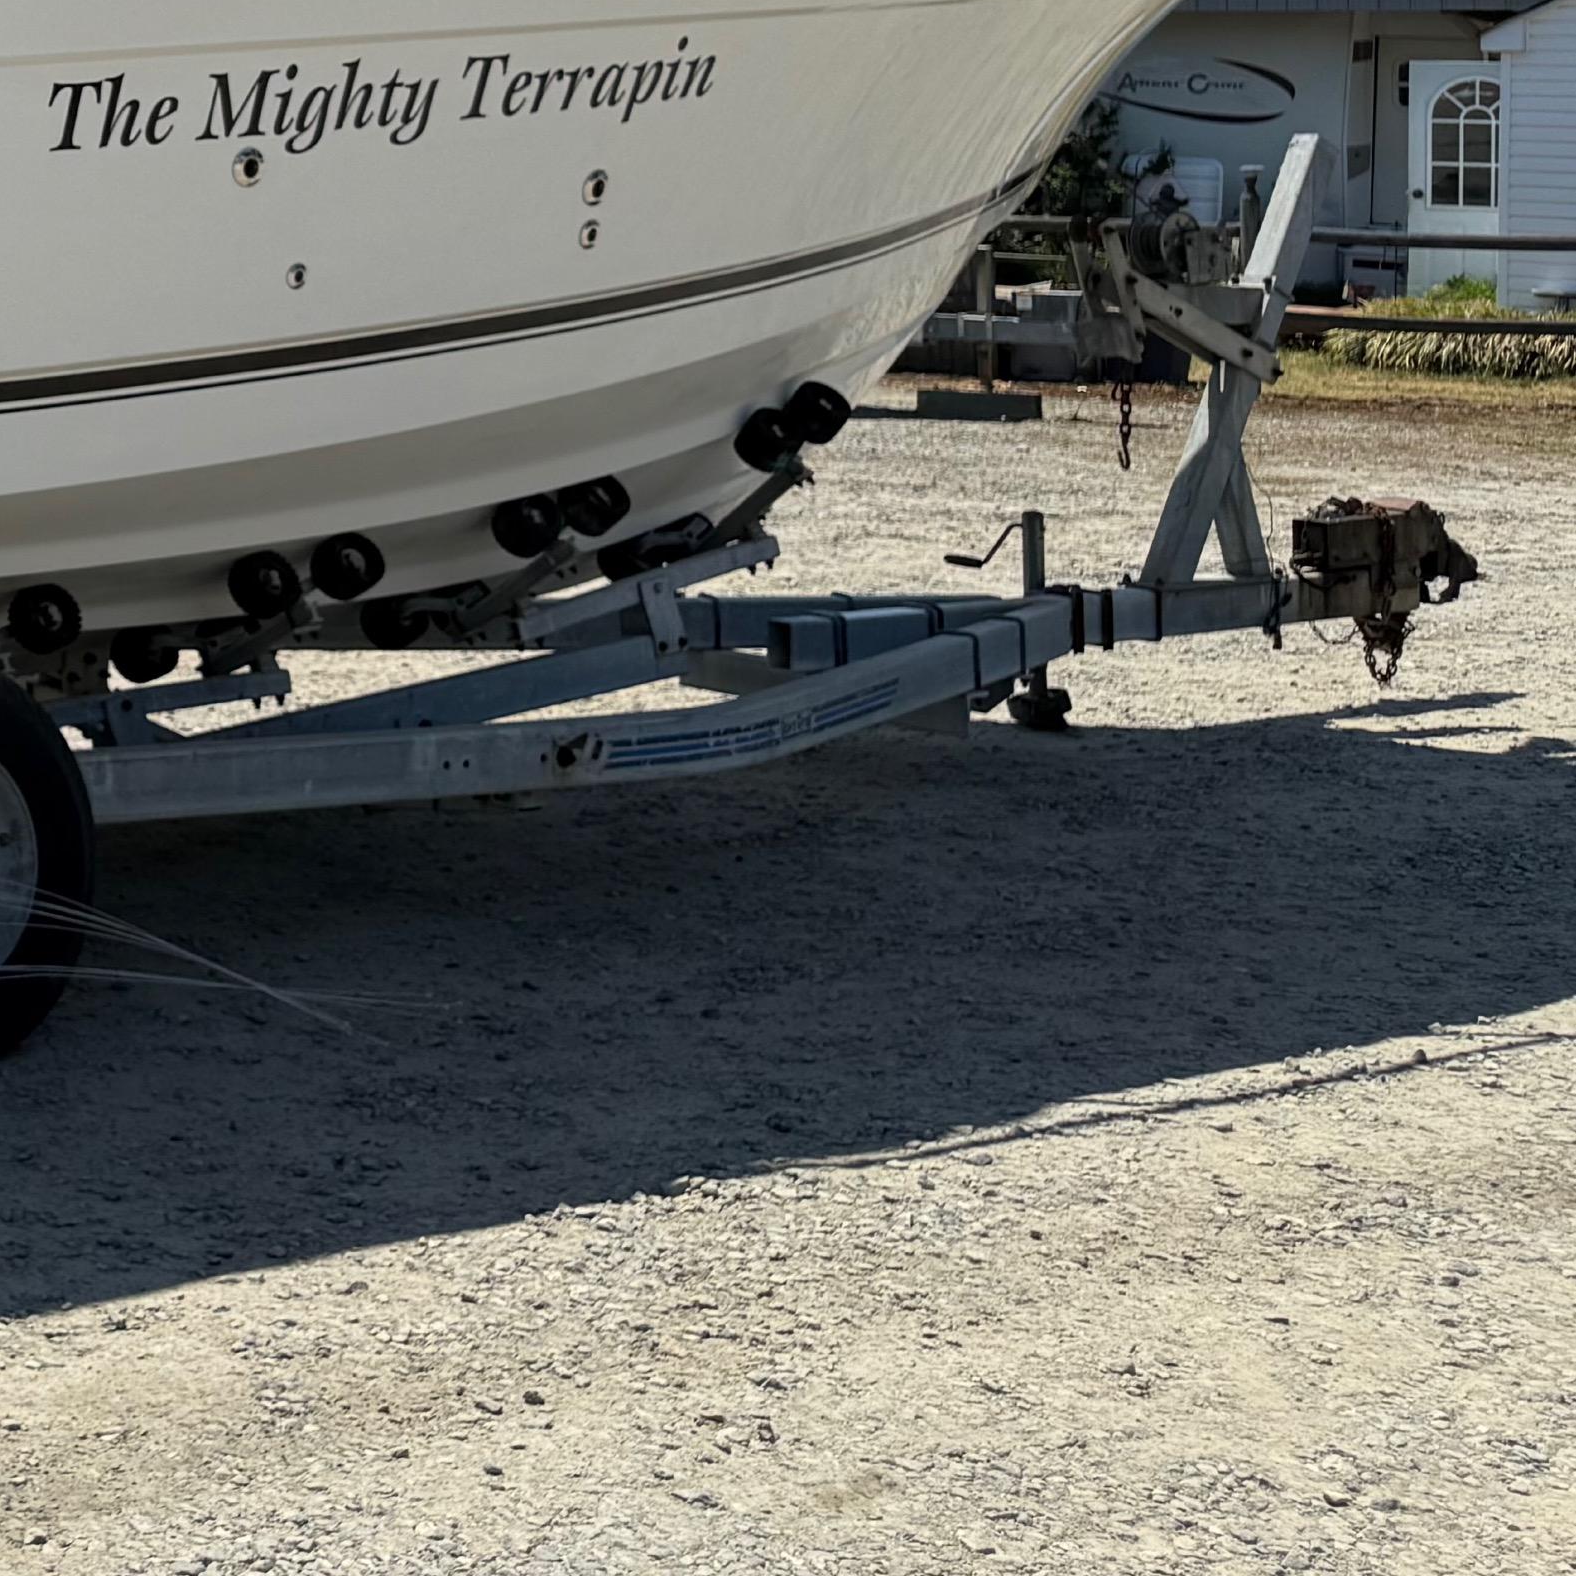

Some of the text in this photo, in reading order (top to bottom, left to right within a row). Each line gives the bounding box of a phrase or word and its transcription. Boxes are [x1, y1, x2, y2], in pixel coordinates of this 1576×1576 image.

[48, 36, 716, 155] The Mighty Terrapin
